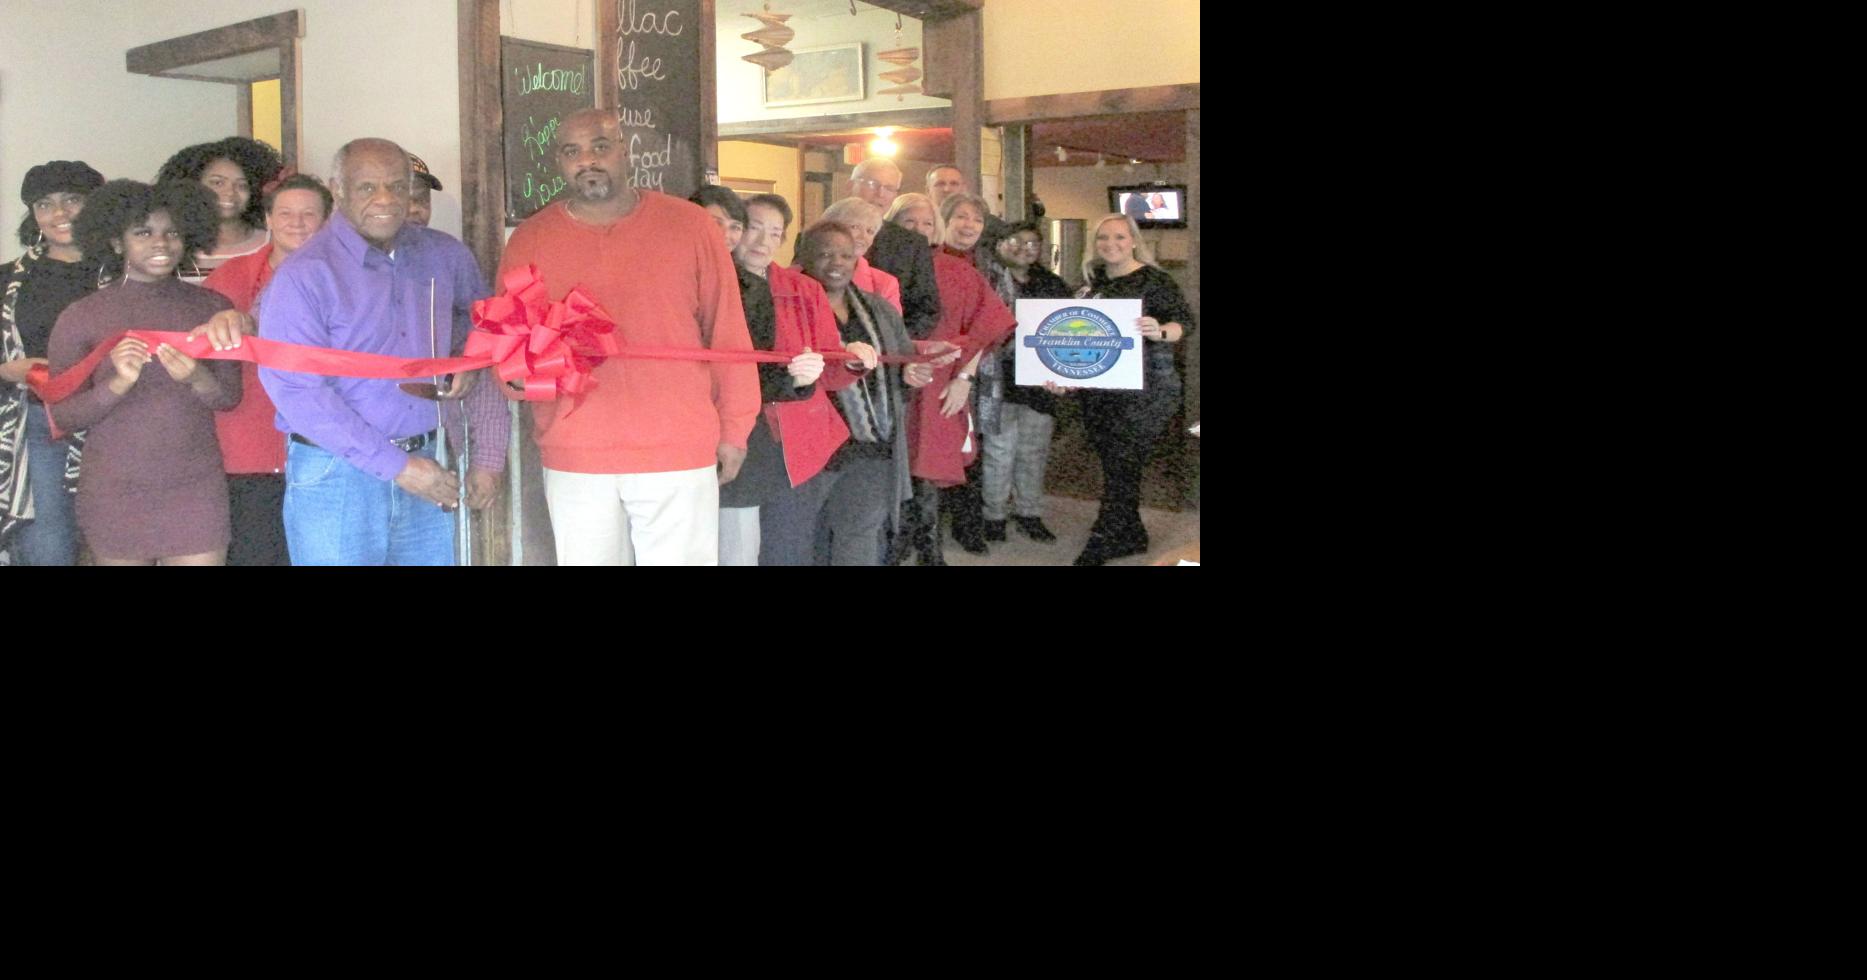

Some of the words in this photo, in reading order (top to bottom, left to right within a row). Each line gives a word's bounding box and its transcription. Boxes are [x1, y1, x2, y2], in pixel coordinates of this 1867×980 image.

[1037, 337, 1081, 347] Franklin
[1083, 337, 1122, 349] County
[1051, 362, 1106, 376] TENNESSEE
